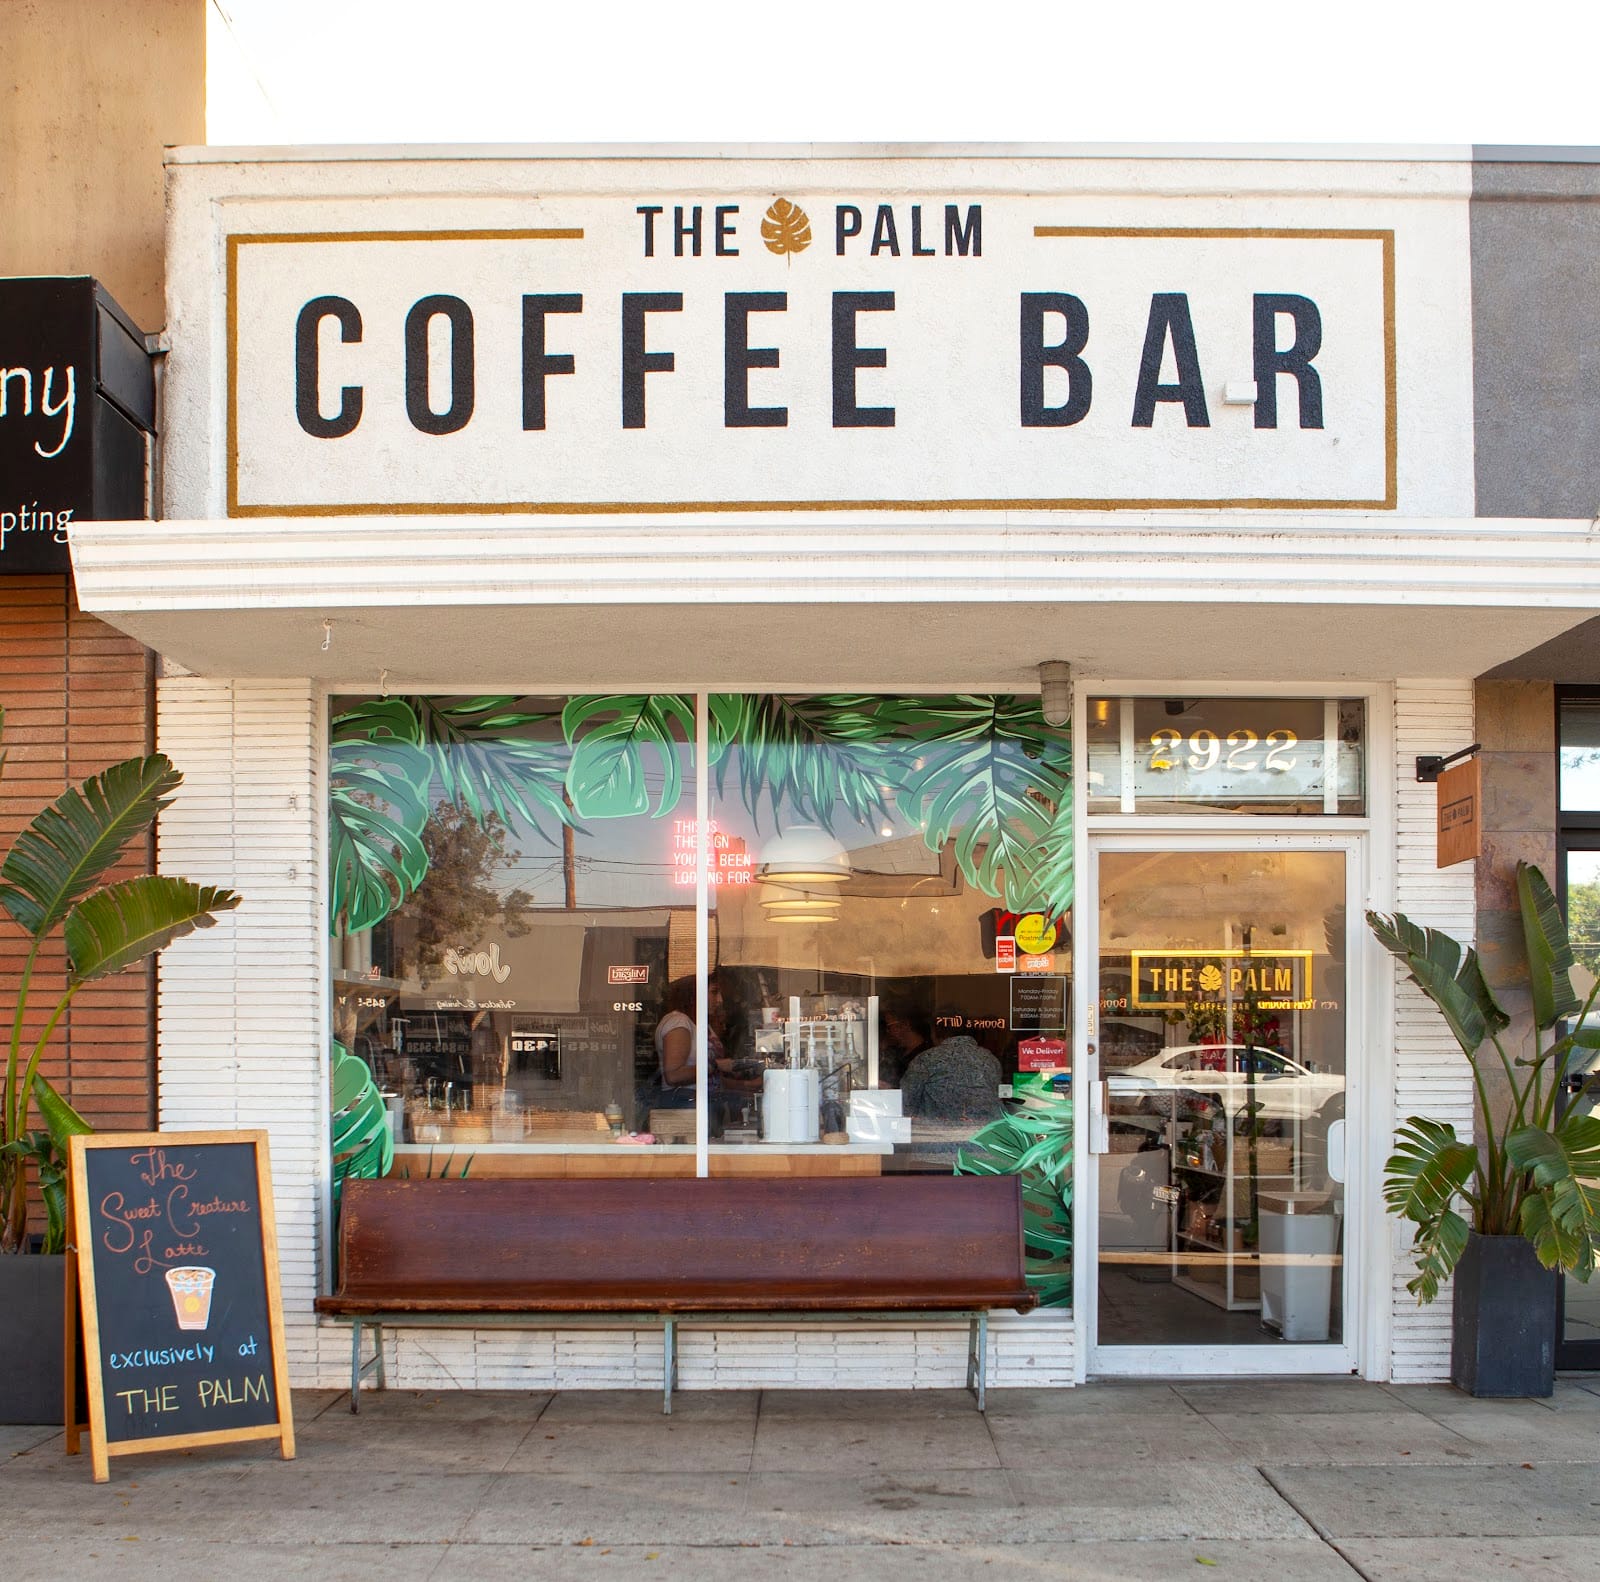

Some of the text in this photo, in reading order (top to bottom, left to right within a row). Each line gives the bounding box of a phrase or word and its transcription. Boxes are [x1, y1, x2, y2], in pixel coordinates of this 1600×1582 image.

[636, 204, 983, 257] THE PALM
[295, 291, 1325, 439] COFFEE BAR
[0, 365, 76, 458] ny
[0, 500, 74, 550] pting
[1150, 728, 1298, 772] 2922
[673, 835, 698, 849] THE
[673, 853, 751, 867] YOUE BEEN
[674, 871, 751, 885] LOONG FOR
[1018, 934, 1053, 942] Postmes
[1150, 968, 1292, 992] THE PALM
[1021, 1047, 1064, 1055] We Deliver!
[130, 1147, 198, 1186] The
[100, 1184, 251, 1252] Sweet Creature
[134, 1229, 210, 1275] Latte
[110, 1335, 258, 1370] exclusively at
[115, 1374, 270, 1414] THE PALM
